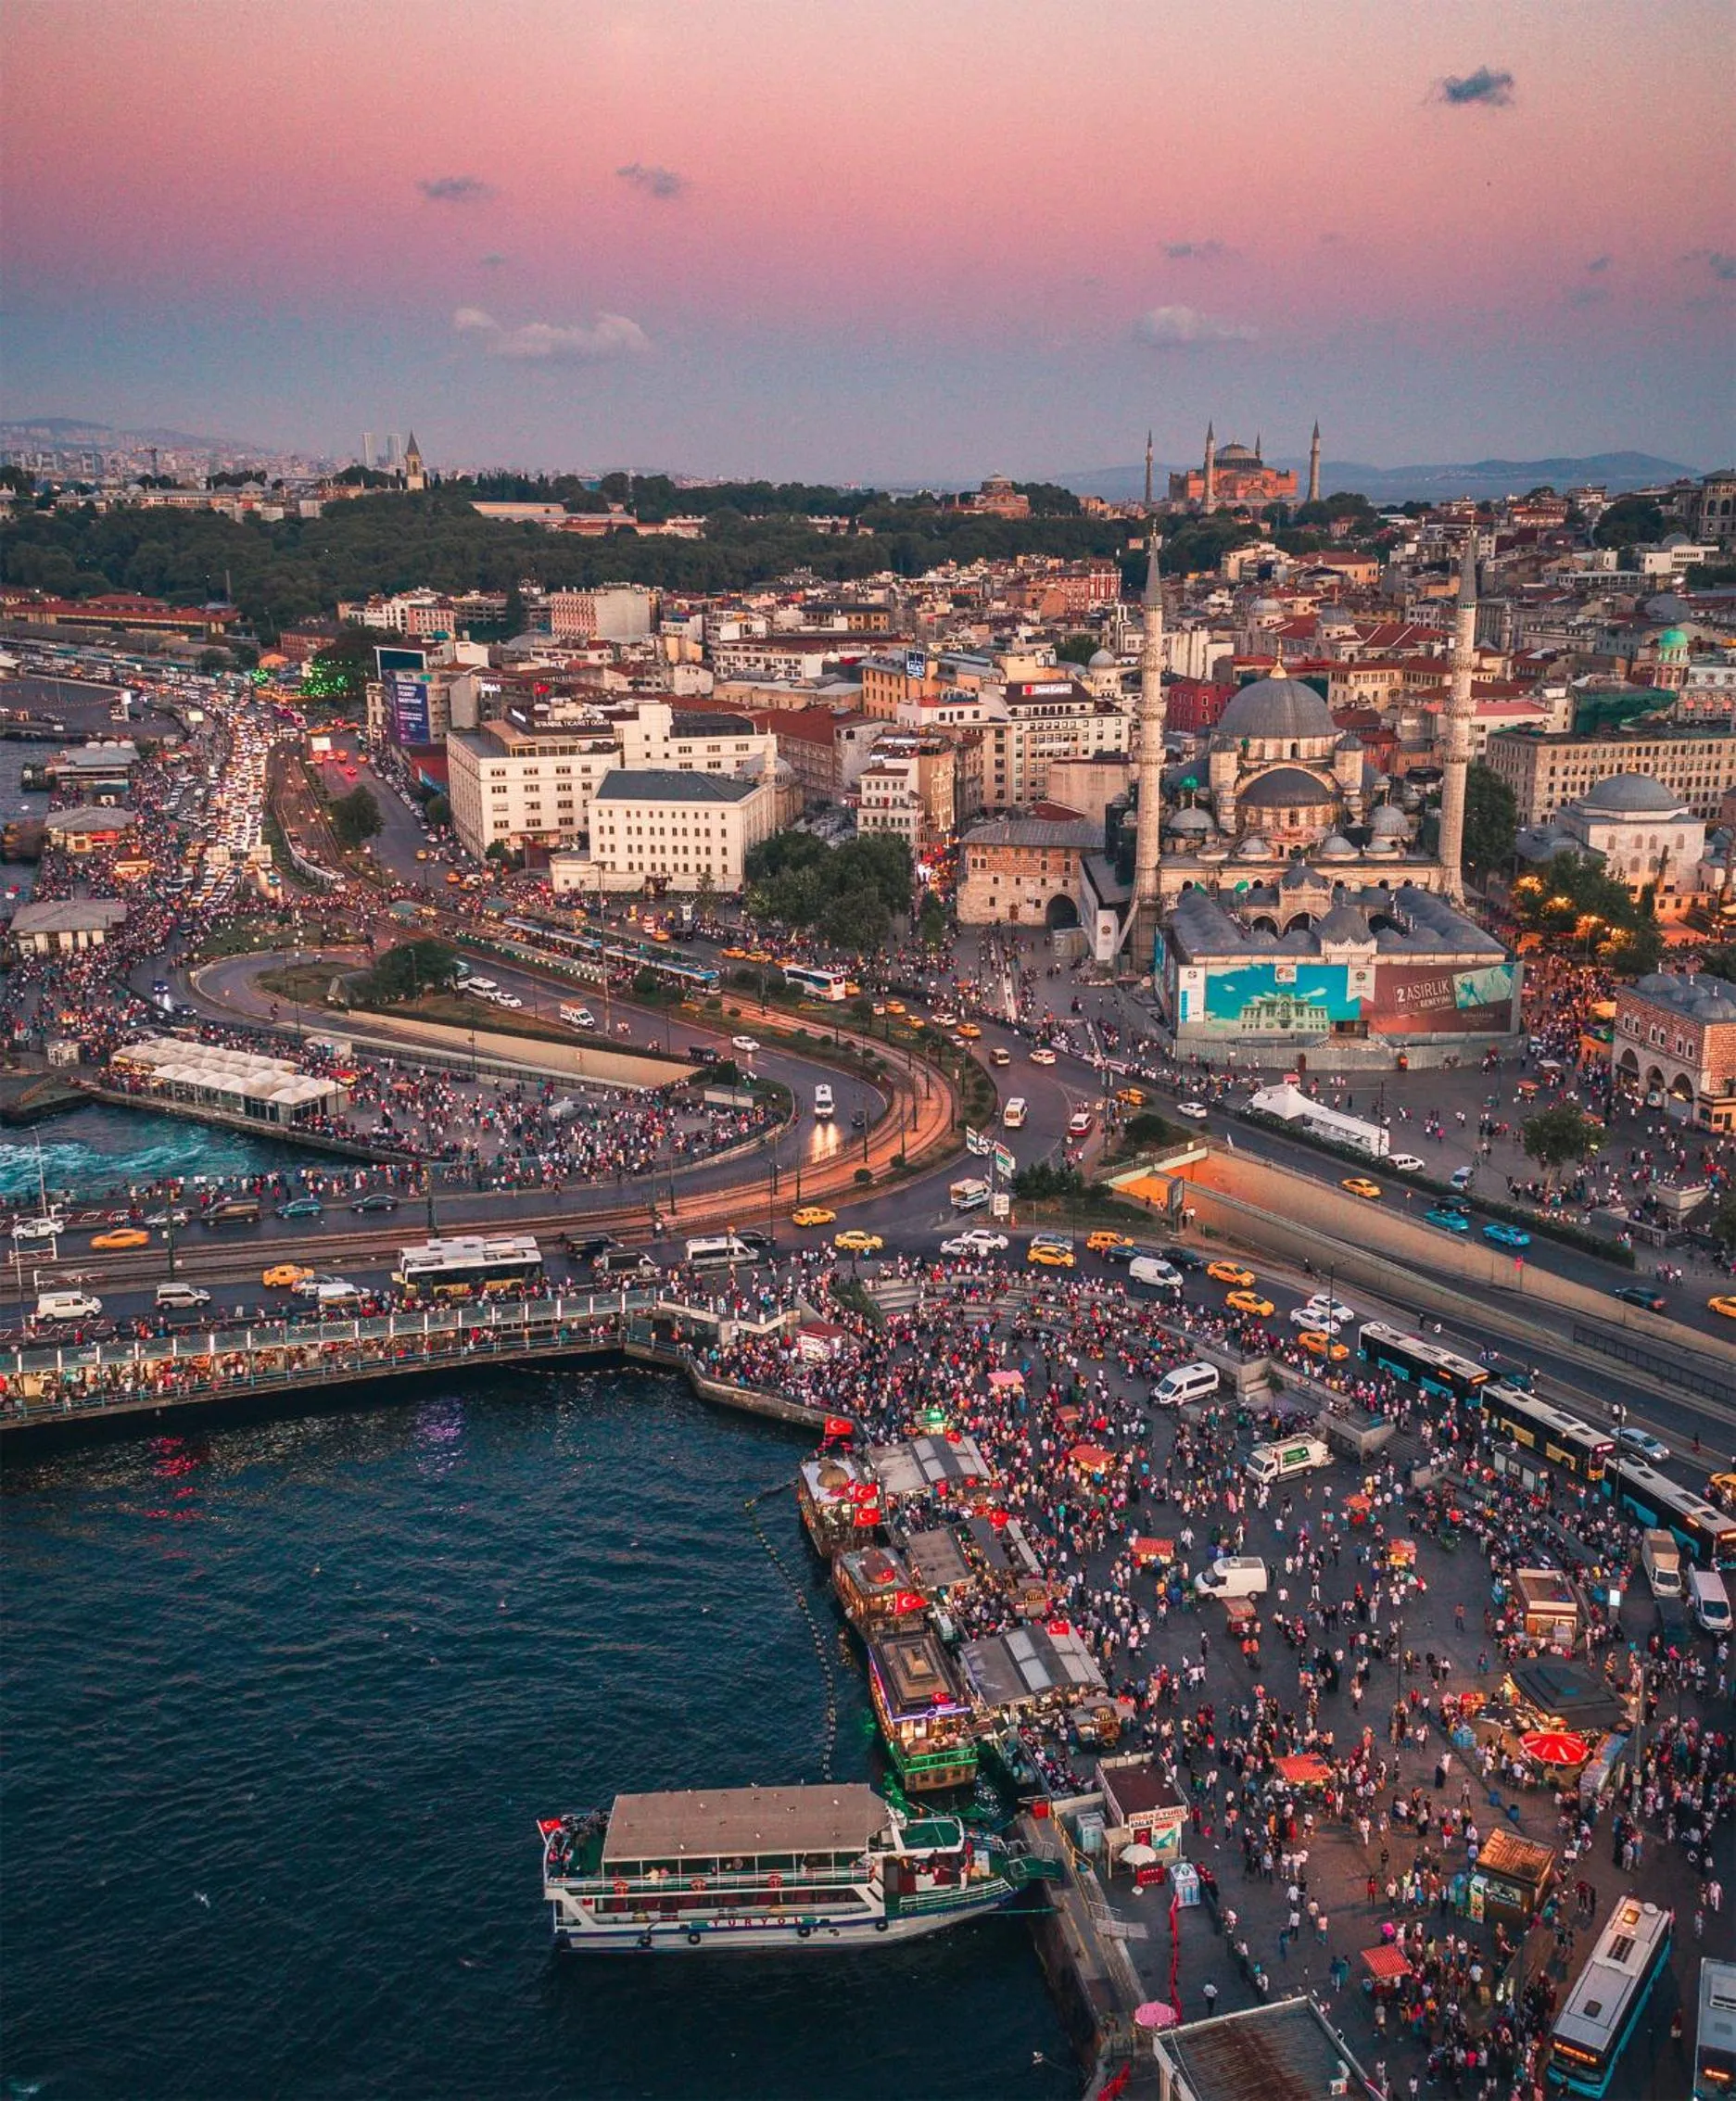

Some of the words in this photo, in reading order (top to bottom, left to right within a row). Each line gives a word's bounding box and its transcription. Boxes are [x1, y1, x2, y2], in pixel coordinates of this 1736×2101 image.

[1396, 988, 1406, 1003] 2
[1407, 980, 1451, 1001] ASIRLIK
[712, 1917, 802, 1928] TURYOL
